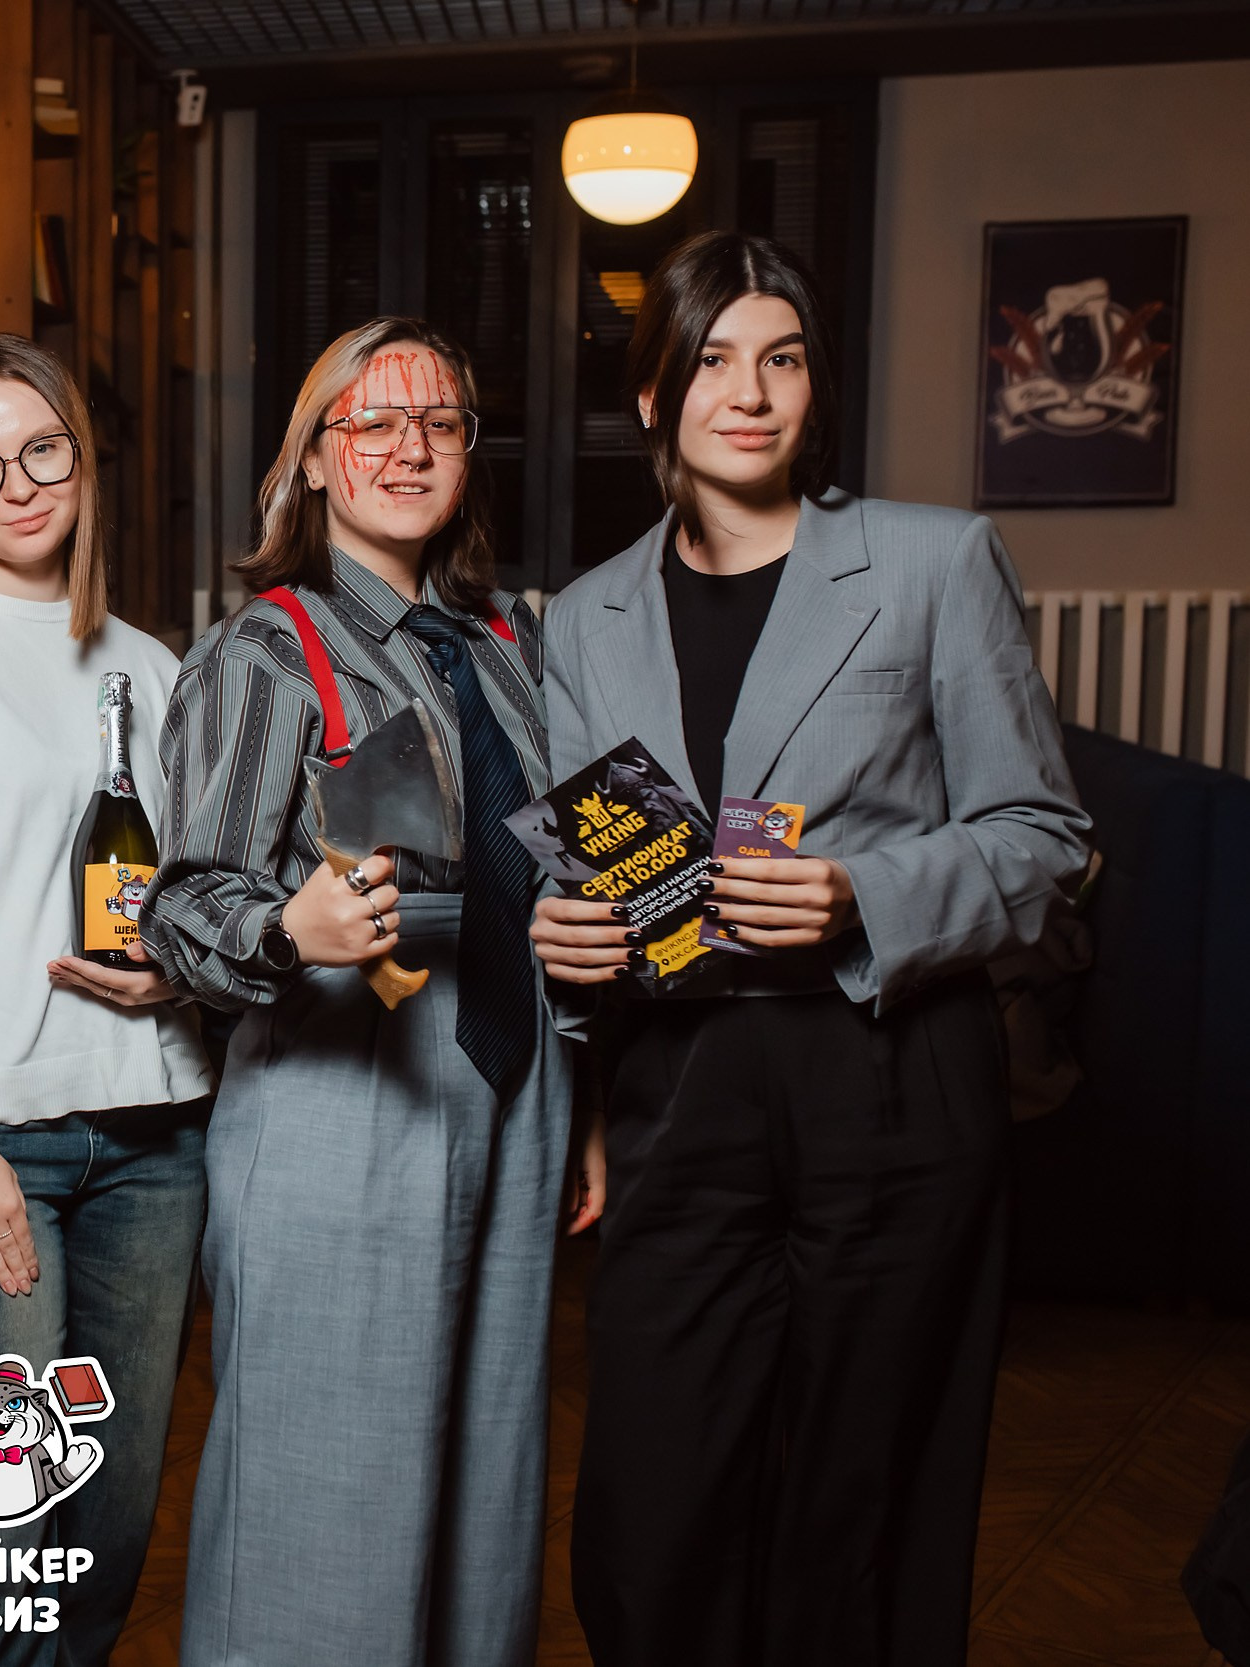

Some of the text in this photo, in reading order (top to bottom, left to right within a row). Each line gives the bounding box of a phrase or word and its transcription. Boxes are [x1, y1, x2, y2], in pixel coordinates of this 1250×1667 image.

[723, 808, 762, 820] ШЕЙКЕР
[728, 820, 753, 830] КВИЗ
[580, 811, 648, 857] VIKING
[737, 845, 771, 857] ОДНА
[581, 821, 692, 896] СЕРТИФИКАТ
[603, 879, 634, 900] НА
[628, 844, 687, 885] 10.000
[658, 883, 668, 893] И
[666, 856, 712, 888] НАПИТКИ
[629, 887, 681, 922] АВТОРСКОЕ
[114, 924, 138, 934] ШЕЙ
